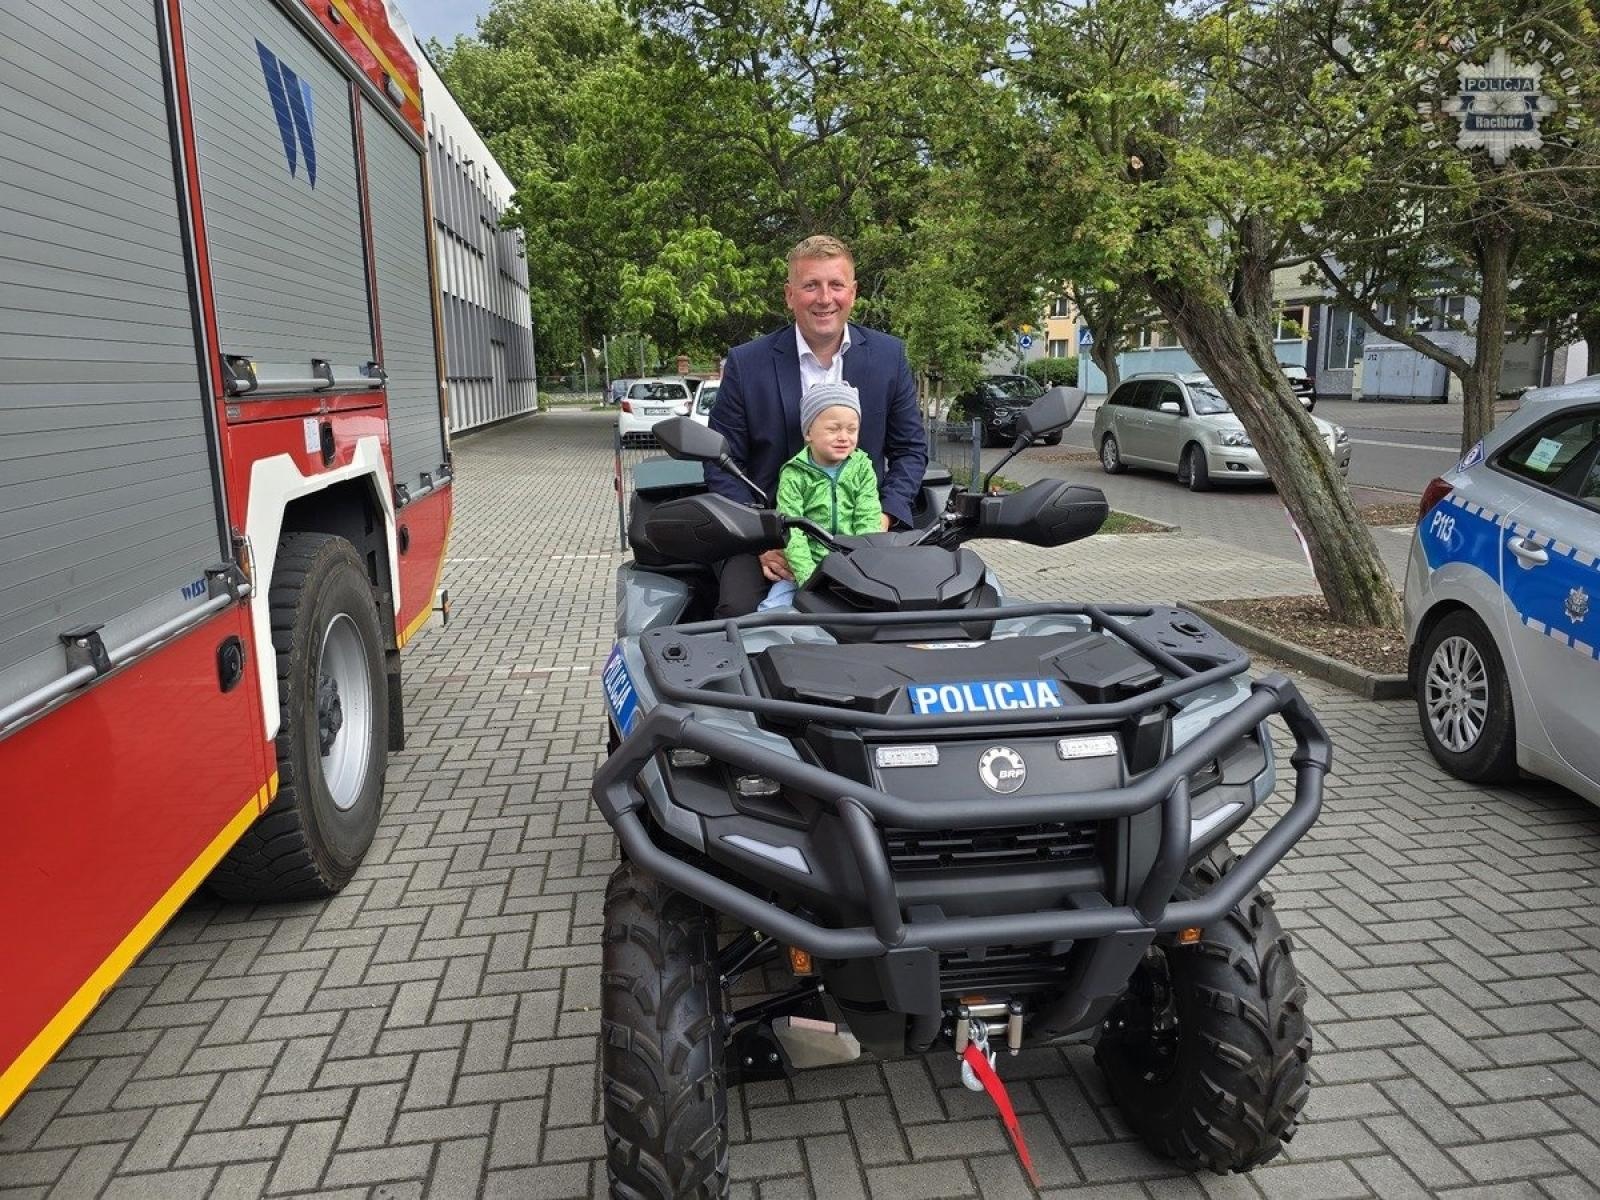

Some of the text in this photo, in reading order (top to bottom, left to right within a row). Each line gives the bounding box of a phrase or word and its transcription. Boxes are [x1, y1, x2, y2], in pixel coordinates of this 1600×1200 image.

[1429, 510, 1456, 542] P113
[603, 654, 632, 716] POLICJA
[914, 681, 1061, 714] POLICJA
[999, 769, 1025, 779] BRP
